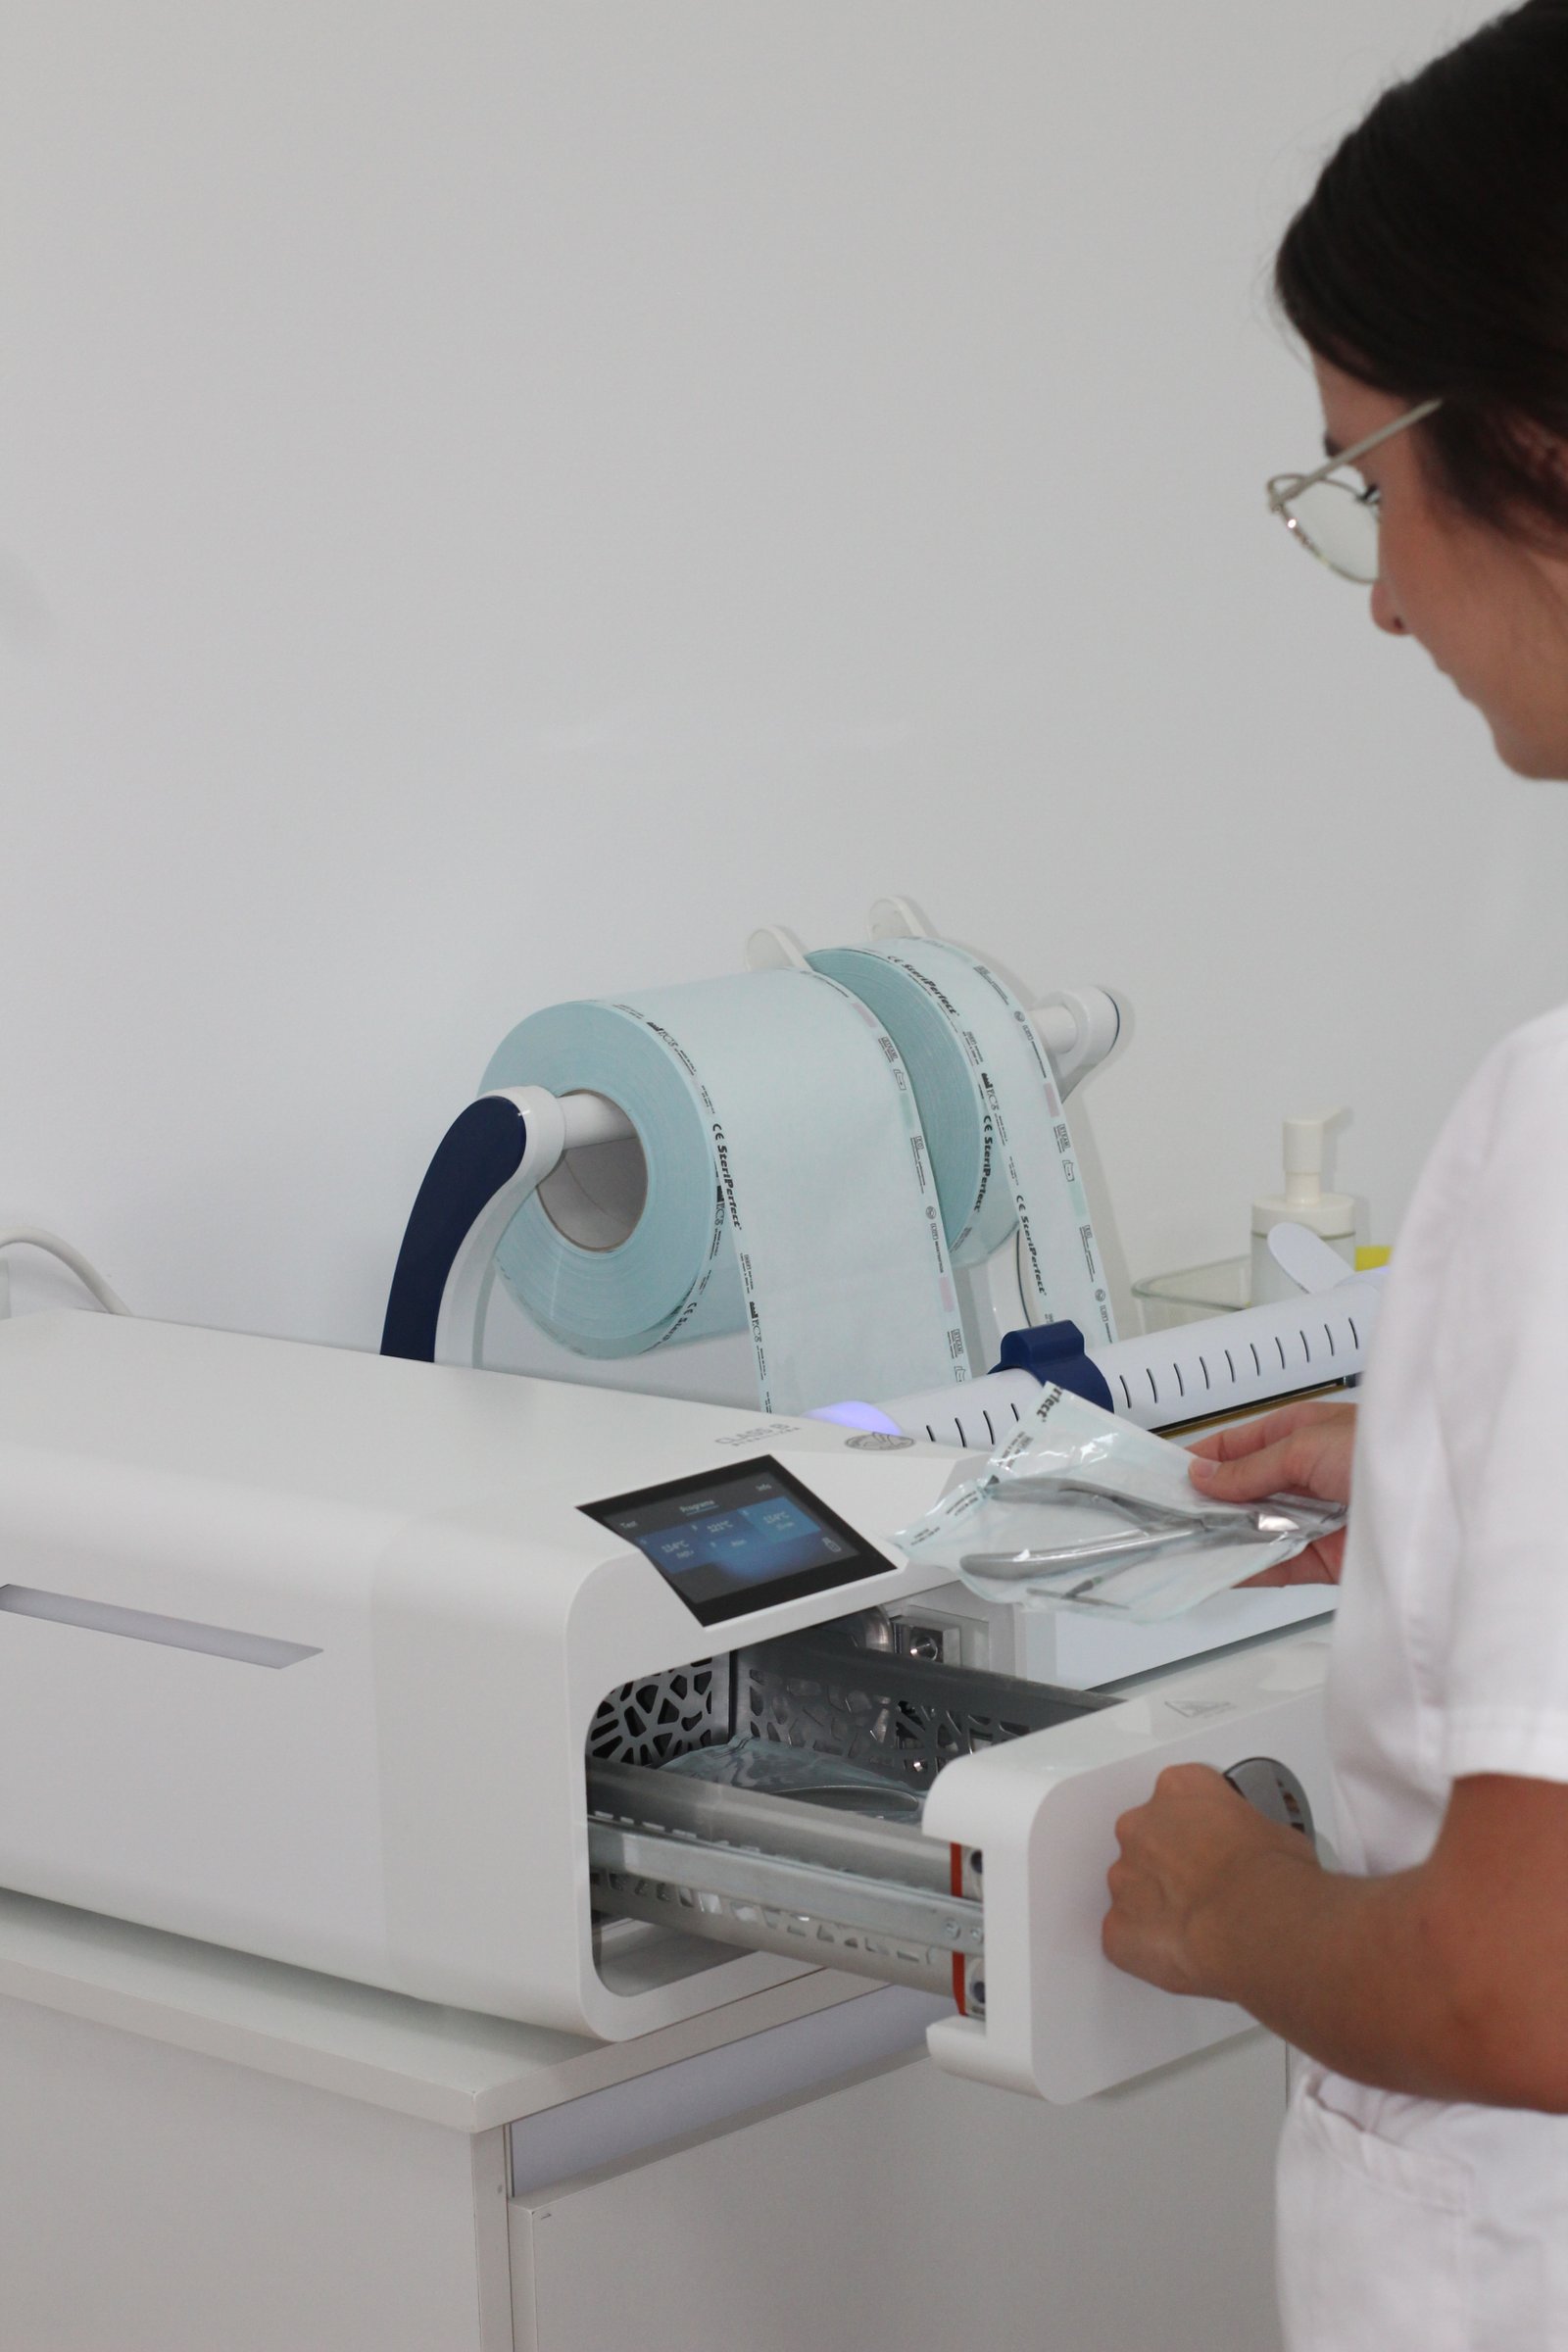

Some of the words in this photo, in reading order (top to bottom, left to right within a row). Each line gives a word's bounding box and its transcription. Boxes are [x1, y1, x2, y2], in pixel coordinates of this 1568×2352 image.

[902, 963, 957, 1014] SteriPerfect
[717, 1145, 740, 1228] SteriPerfect
[974, 1136, 993, 1212] SteriPerfect
[1021, 1215, 1045, 1295] SteriPerfect
